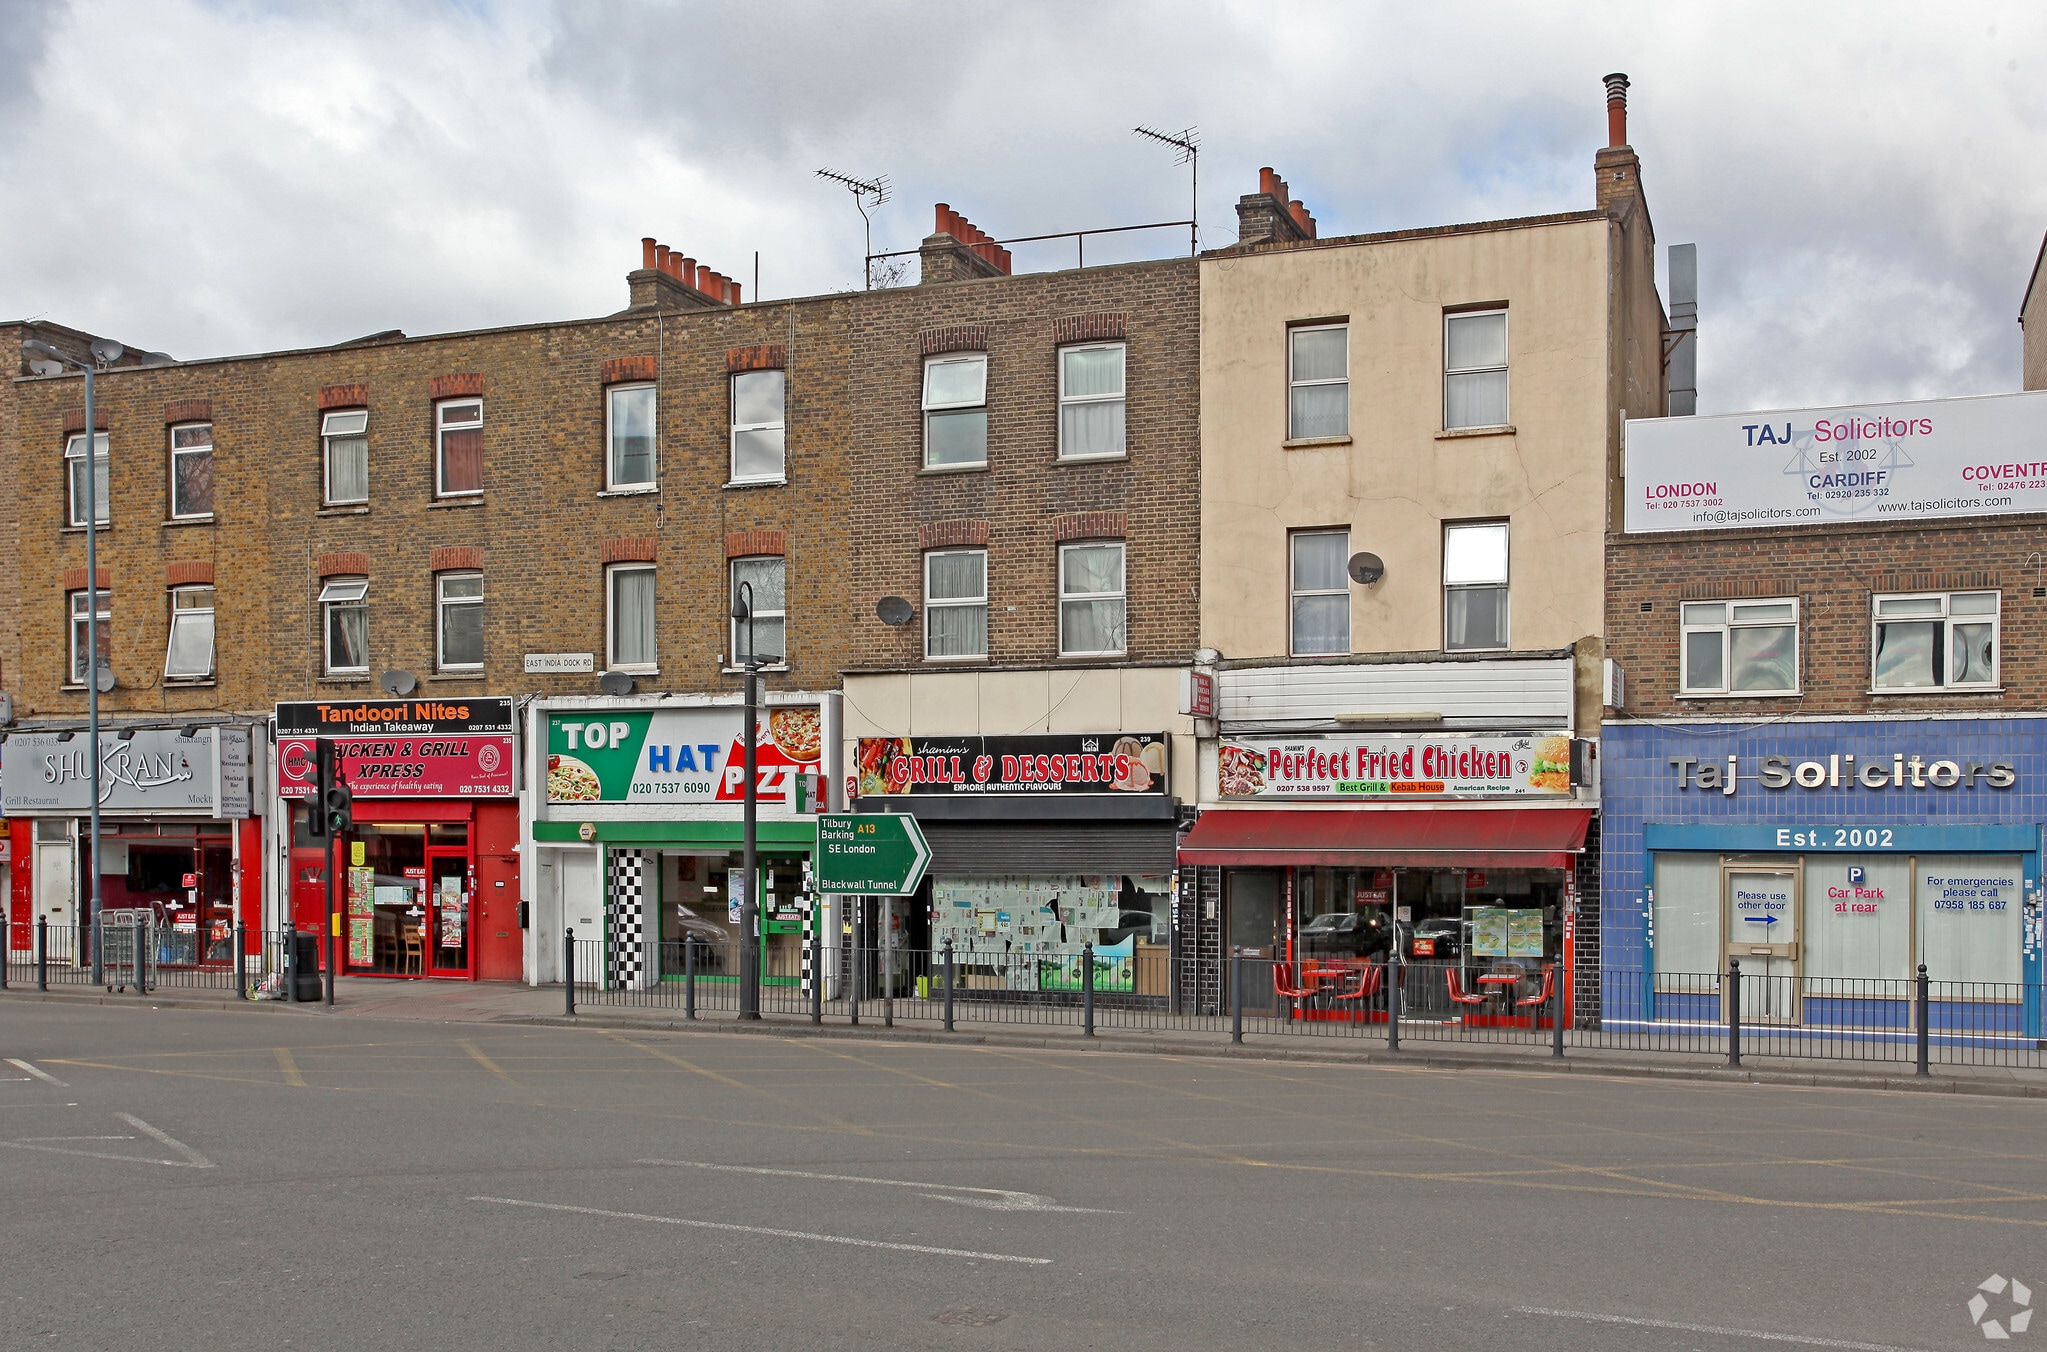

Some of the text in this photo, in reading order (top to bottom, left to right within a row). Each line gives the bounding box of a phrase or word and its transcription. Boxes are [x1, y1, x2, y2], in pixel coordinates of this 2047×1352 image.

[1742, 416, 1933, 447] TAJ Solicitors
[1819, 448, 1877, 463] Est. 2002
[1809, 470, 1887, 489] CARDIFF
[1978, 479, 2046, 491] Tel: 02476 223
[1646, 482, 1717, 499] LONDON
[1807, 488, 1889, 500] Tel: 02920 235 332
[1645, 498, 1723, 510] Tel: 020 7537 3002
[1877, 495, 2012, 513] www.tajsolicitors.com
[1692, 505, 1821, 523] info@tajsolicitors.com
[526, 658, 592, 667] EAST INDIA DOCK RD
[317, 703, 470, 722] Tandoori Nites
[350, 722, 435, 733] Indian Takeaway
[561, 722, 631, 750] TOP
[736, 732, 747, 743] Fre
[15, 738, 31, 747] 0207
[33, 738, 45, 746] 536
[917, 739, 970, 755] shamim's
[334, 741, 470, 758] HICKEN & GRILL
[649, 744, 721, 773] HAT
[1268, 744, 1513, 780] Perfect Fried Chicken
[356, 763, 426, 779] XPRESS
[891, 753, 1130, 784] GRILL & DESSERTS
[1668, 753, 2016, 796] Taj Solicitors
[725, 765, 819, 794] PZZ
[281, 786, 293, 794] 020
[295, 786, 310, 794] 7531
[360, 782, 390, 793] experience
[391, 780, 399, 793] of
[399, 780, 422, 793] healthy
[423, 782, 443, 793] eating
[460, 785, 472, 793] 020
[474, 785, 490, 793] 7531
[633, 782, 711, 794] 020 7537 6090
[953, 782, 1062, 791] EXPLORE AUTHENTIC FLAVOURS
[1340, 782, 1386, 792] Best Grill &
[1391, 782, 1445, 792] Kebab House
[1487, 784, 1511, 792] Recipe
[5, 796, 59, 805] Grill Restaurant
[821, 818, 852, 829] Tilbury
[857, 824, 876, 834] A13
[821, 829, 855, 841] Barking
[1776, 828, 1893, 848] Est. 2002
[828, 843, 876, 854] SE London
[1850, 868, 1862, 882] P
[821, 879, 897, 889] Blackwall Tunnel
[1927, 876, 2014, 888] For emergencies
[1356, 891, 1372, 899] JUST
[1737, 890, 1787, 900] Please use
[1827, 886, 1885, 899] Car Park
[1943, 887, 1998, 898] please call
[1737, 901, 1786, 910] other door
[1834, 902, 1878, 913] at rear
[1934, 900, 2007, 910] 07958 185 687
